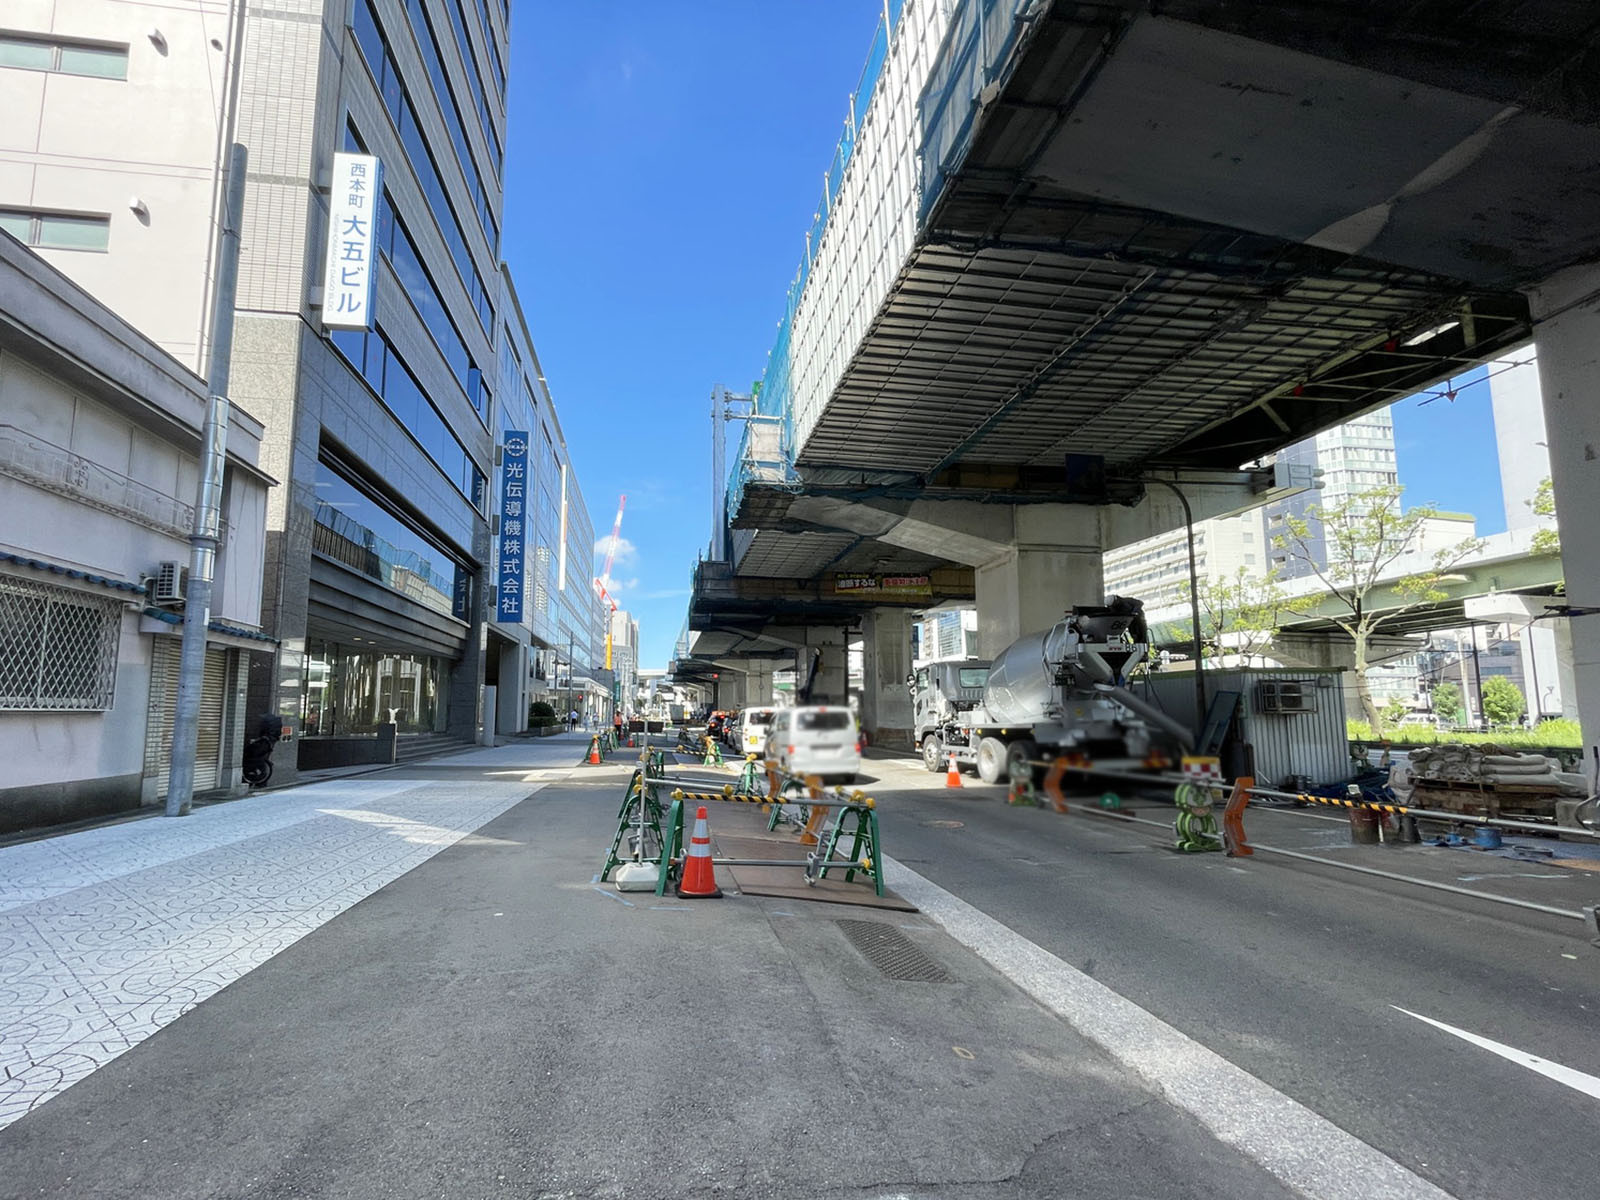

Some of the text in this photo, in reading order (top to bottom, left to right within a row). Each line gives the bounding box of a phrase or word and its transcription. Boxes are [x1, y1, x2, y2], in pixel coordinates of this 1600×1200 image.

[336, 163, 367, 313] 西本町 大五ビル
[501, 463, 524, 614] 光伝導機株式会社
[1125, 643, 1137, 652] 86
